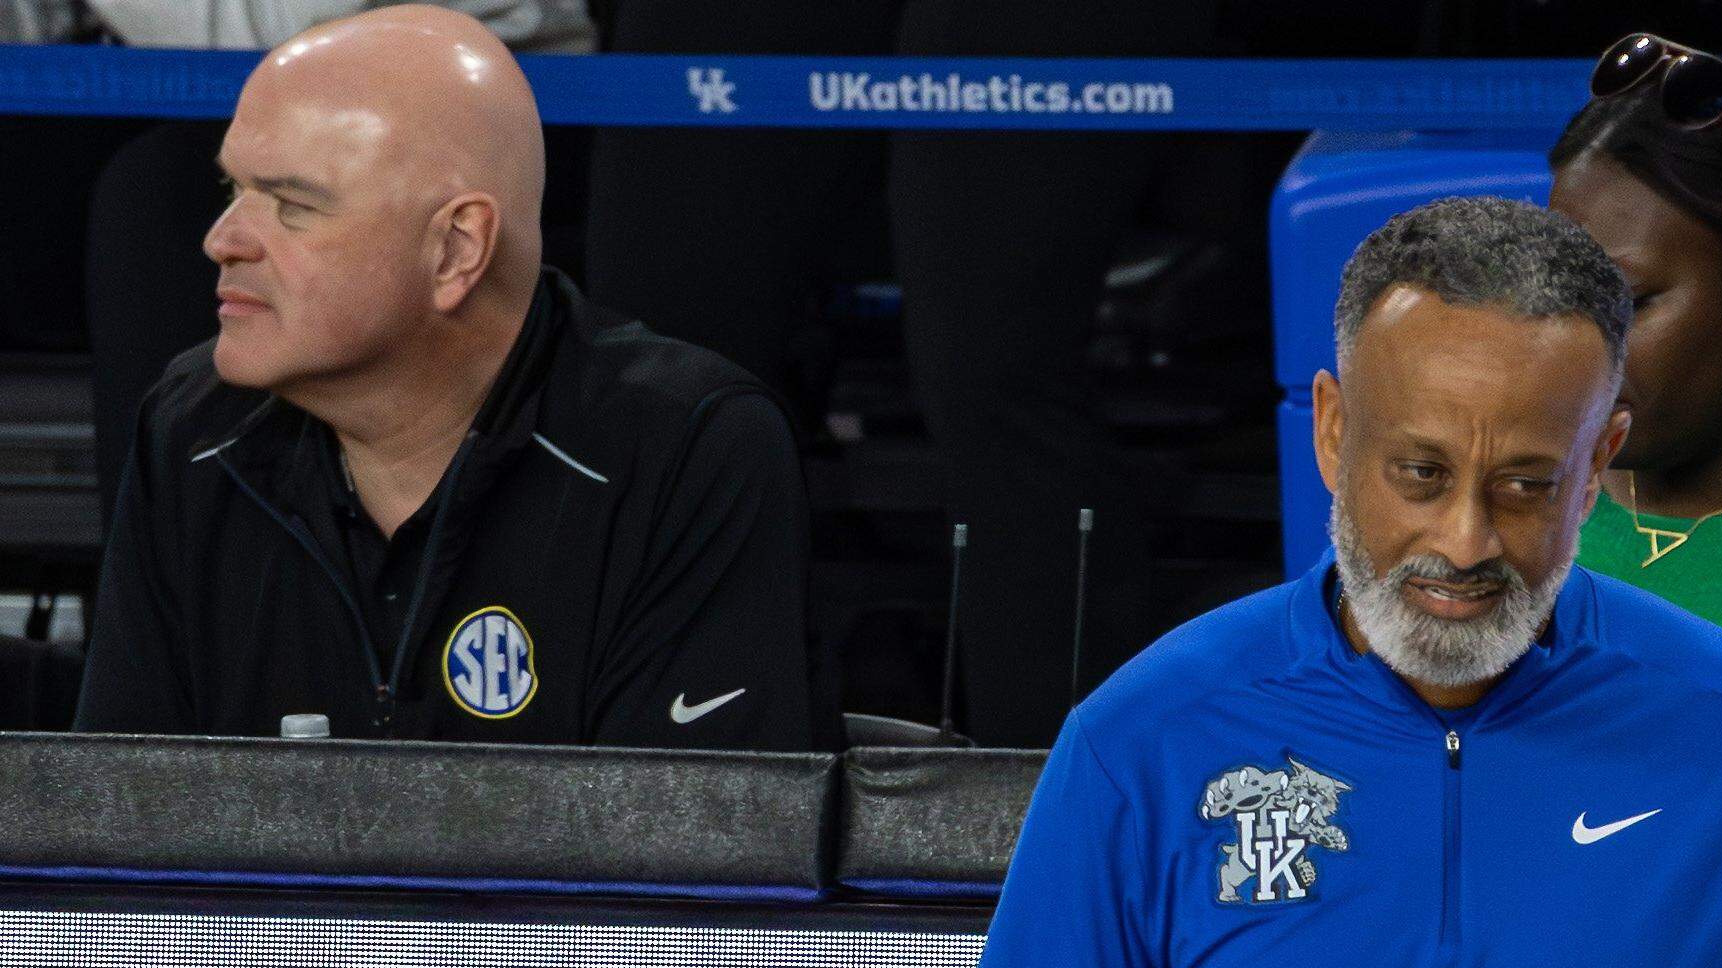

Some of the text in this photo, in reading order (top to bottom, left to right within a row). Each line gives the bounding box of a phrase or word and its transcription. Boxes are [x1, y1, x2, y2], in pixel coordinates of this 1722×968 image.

[687, 67, 1174, 114] UK UKathletics.com
[453, 614, 532, 712] SEC
[1237, 810, 1306, 901] UK
